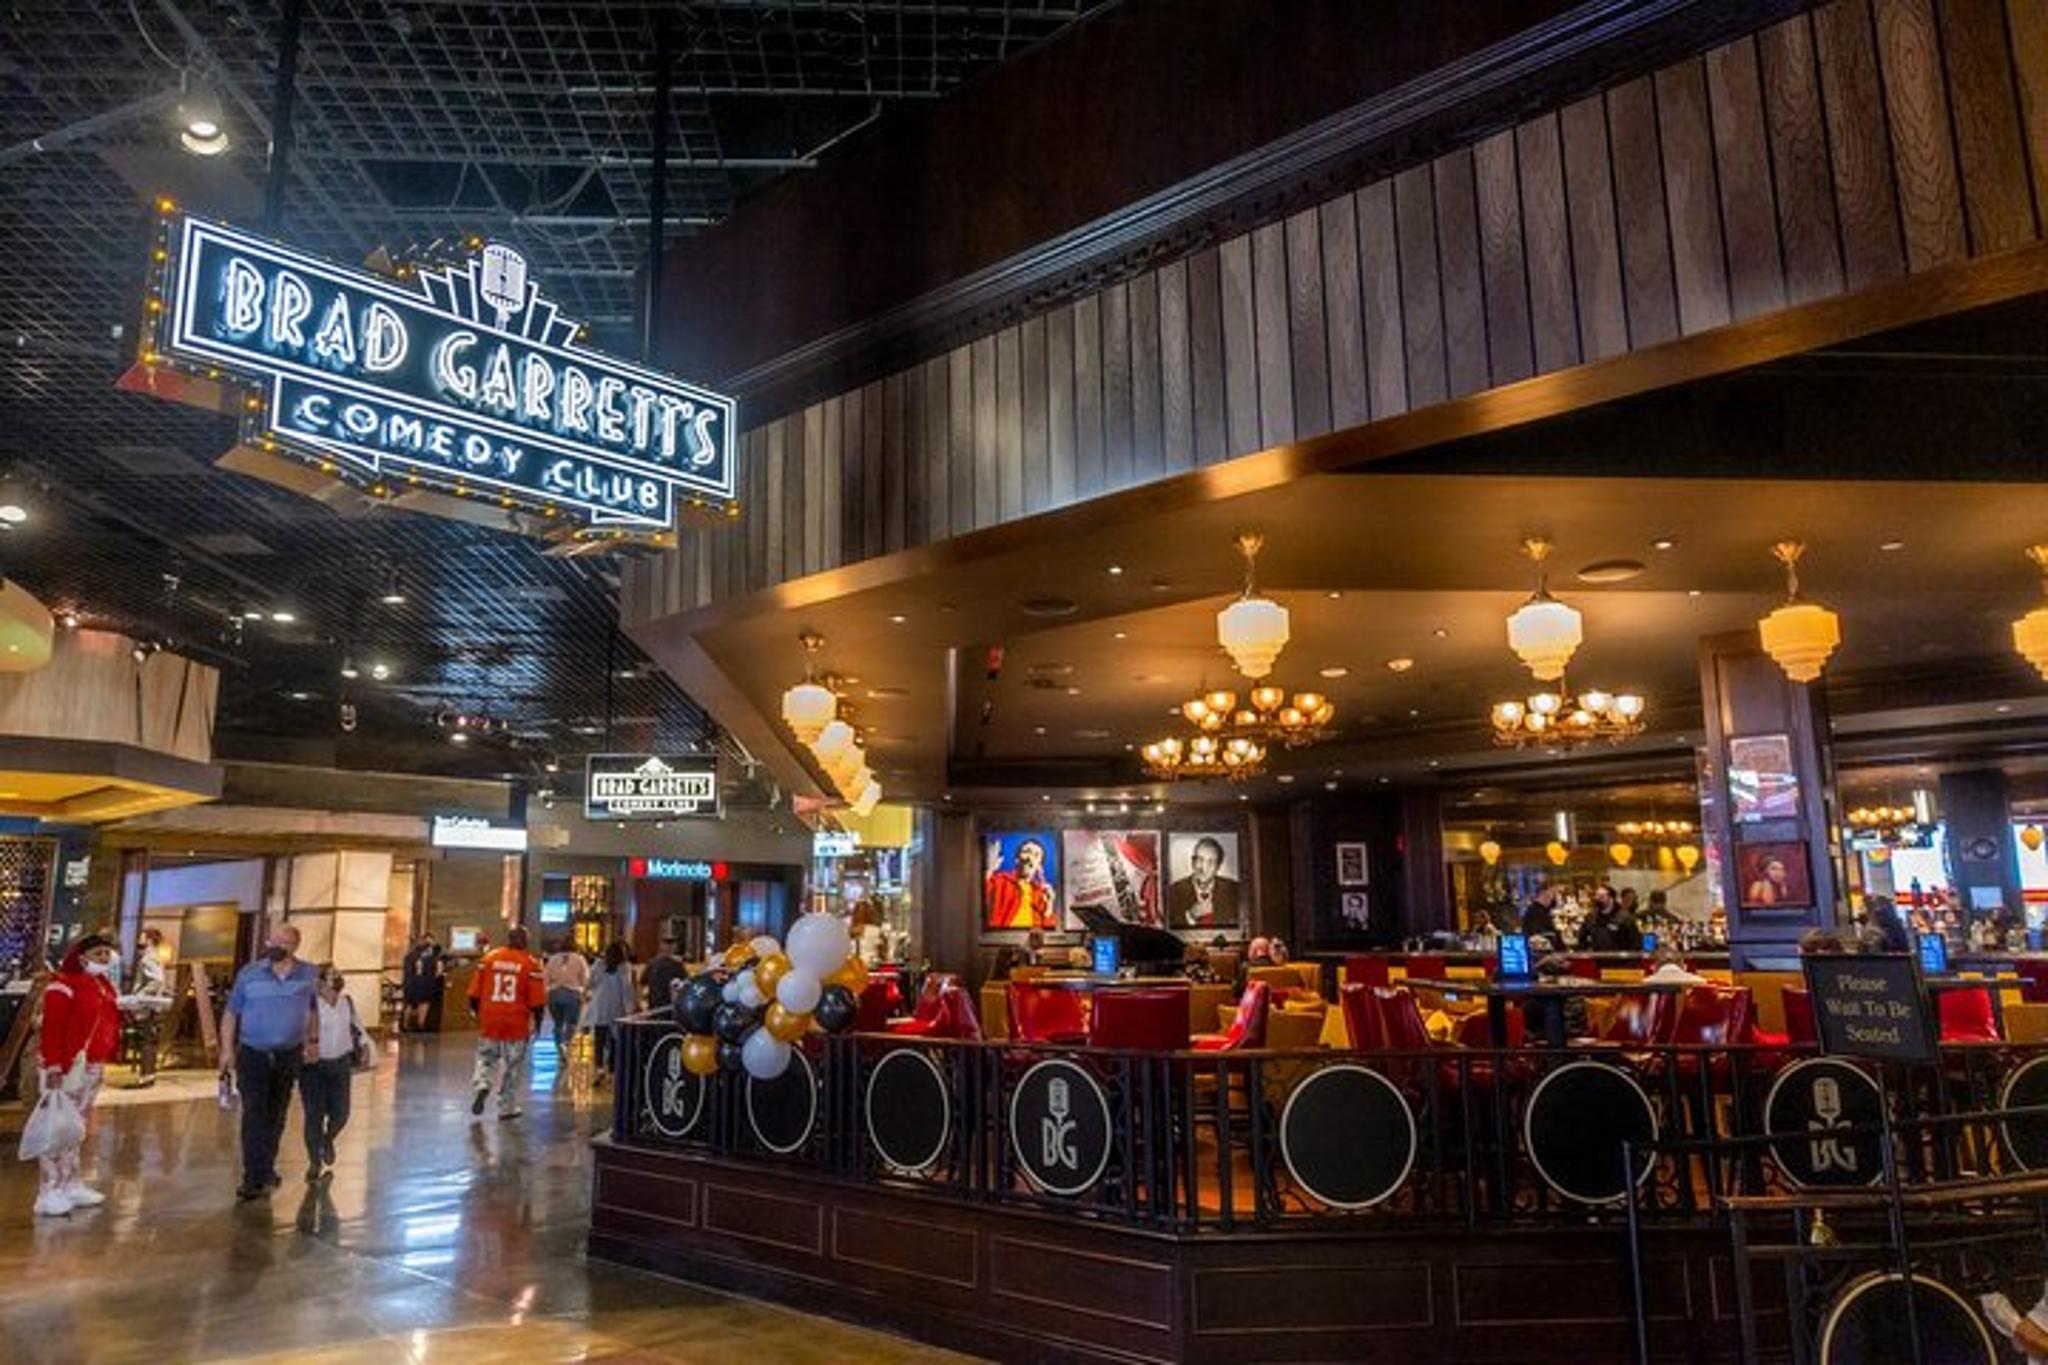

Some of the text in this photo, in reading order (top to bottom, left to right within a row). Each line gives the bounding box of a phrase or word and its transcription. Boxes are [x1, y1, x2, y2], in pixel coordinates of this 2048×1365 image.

[225, 257, 716, 466] BRAD GARRETT'S
[298, 395, 659, 508] COMEDY CLUB
[491, 971, 517, 1002] 13
[1837, 974, 1888, 992] Please
[1825, 999, 1912, 1018] Wait To Be
[1845, 1023, 1901, 1044] Seated
[1042, 1117, 1078, 1170] BG
